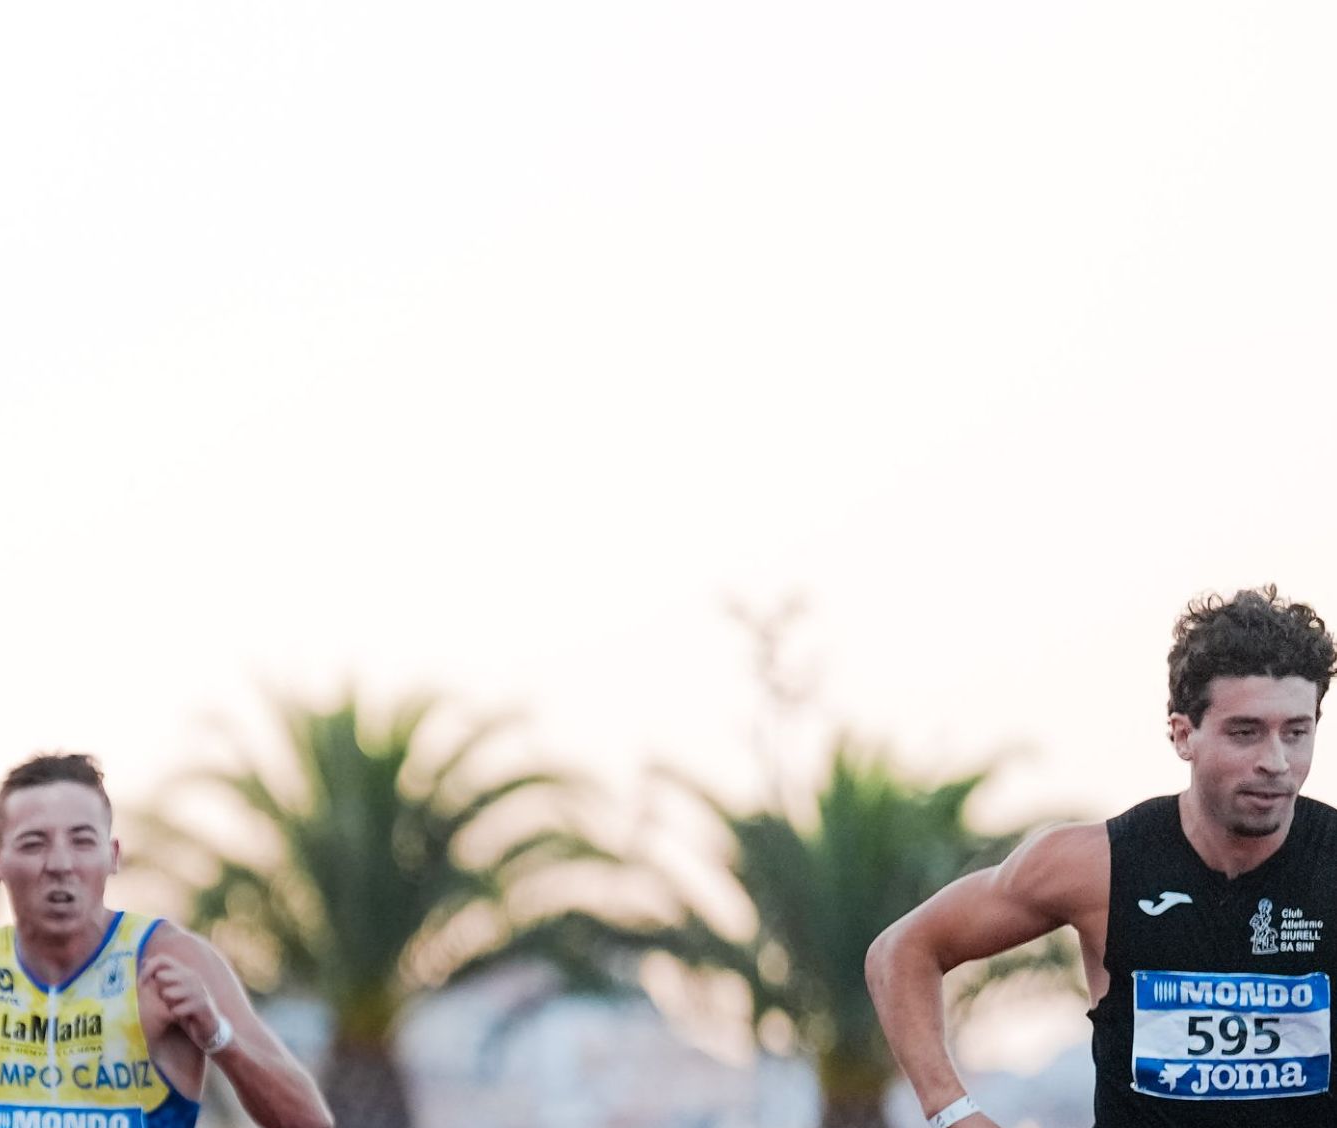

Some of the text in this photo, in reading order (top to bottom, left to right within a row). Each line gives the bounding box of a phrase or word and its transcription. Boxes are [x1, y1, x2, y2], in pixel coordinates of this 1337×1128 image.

[1281, 907, 1303, 919] Club
[1280, 930, 1321, 941] SIURELL
[1295, 941, 1314, 952] SINI
[1180, 981, 1313, 1007] MONDO
[1187, 1015, 1281, 1056] 595
[72, 1057, 154, 1090] CÁDIZ
